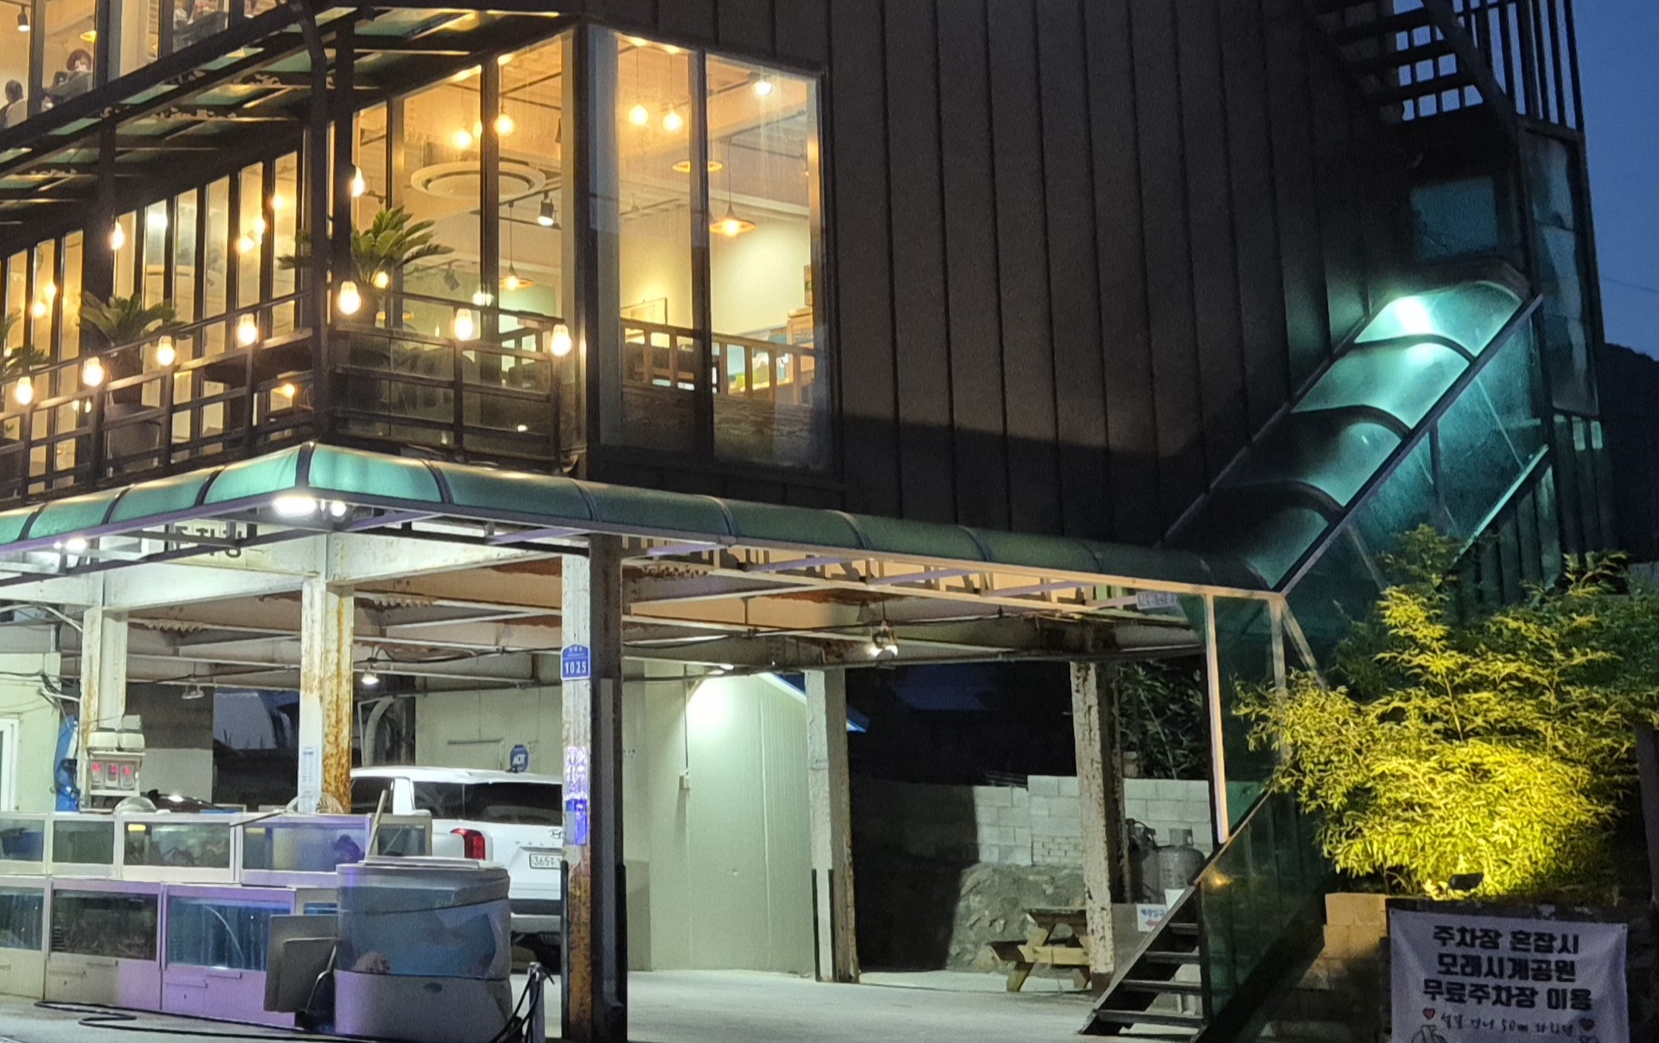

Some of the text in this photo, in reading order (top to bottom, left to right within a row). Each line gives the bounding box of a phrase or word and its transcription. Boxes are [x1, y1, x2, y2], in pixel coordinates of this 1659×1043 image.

[564, 661, 587, 675] 1025
[512, 753, 526, 765] ADT
[1433, 925, 1579, 954] 주차장 혼잡시
[1437, 952, 1576, 982] 모래시계공원
[1423, 978, 1593, 1011] 무료주차장 이용
